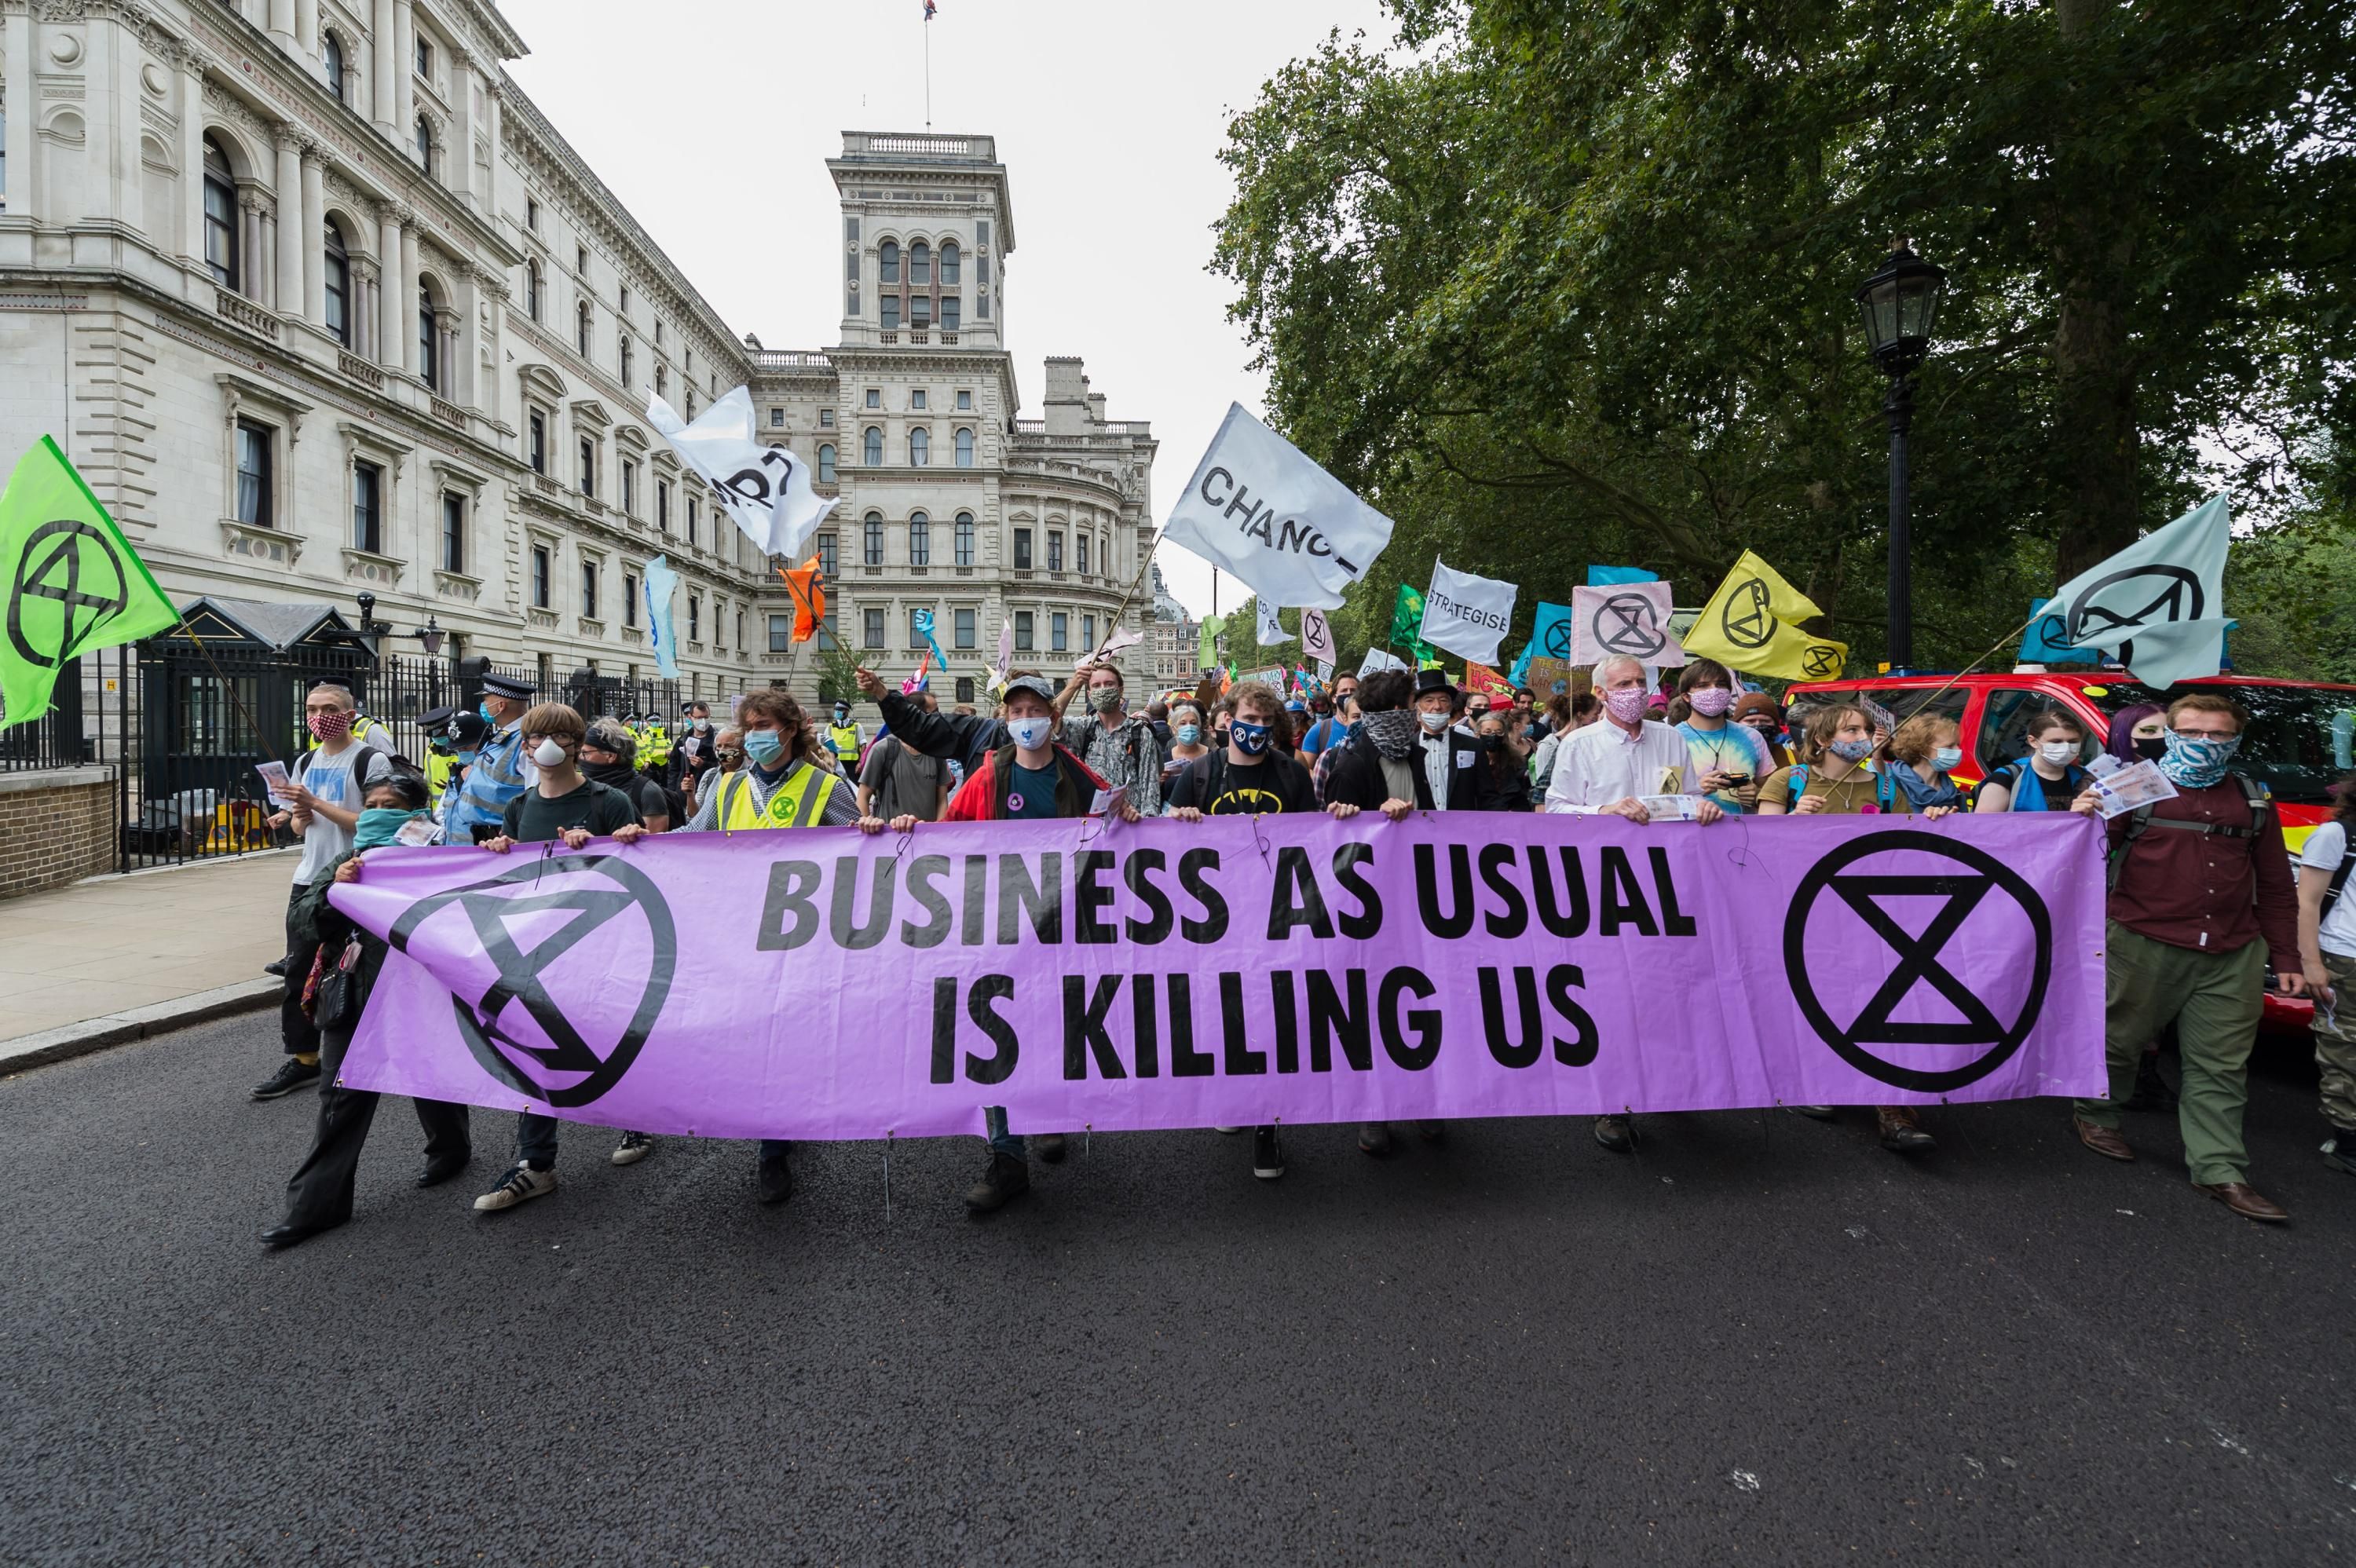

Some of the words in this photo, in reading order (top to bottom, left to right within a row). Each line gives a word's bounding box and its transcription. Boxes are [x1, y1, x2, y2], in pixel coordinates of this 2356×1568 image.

[1201, 466, 1359, 574] CHANG
[1429, 589, 1507, 633] STRATEGISE
[1537, 658, 1554, 669] THE
[1540, 667, 1550, 678] IS
[1531, 677, 1553, 689] WHY
[1864, 696, 1889, 721] CLIMATE
[755, 848, 1230, 952] BUSINESS
[1266, 842, 1384, 941] AS
[1413, 843, 1698, 940] USUAL
[930, 974, 1020, 1085] IS
[1062, 966, 1443, 1081] KILLING
[1477, 964, 1600, 1069] US
